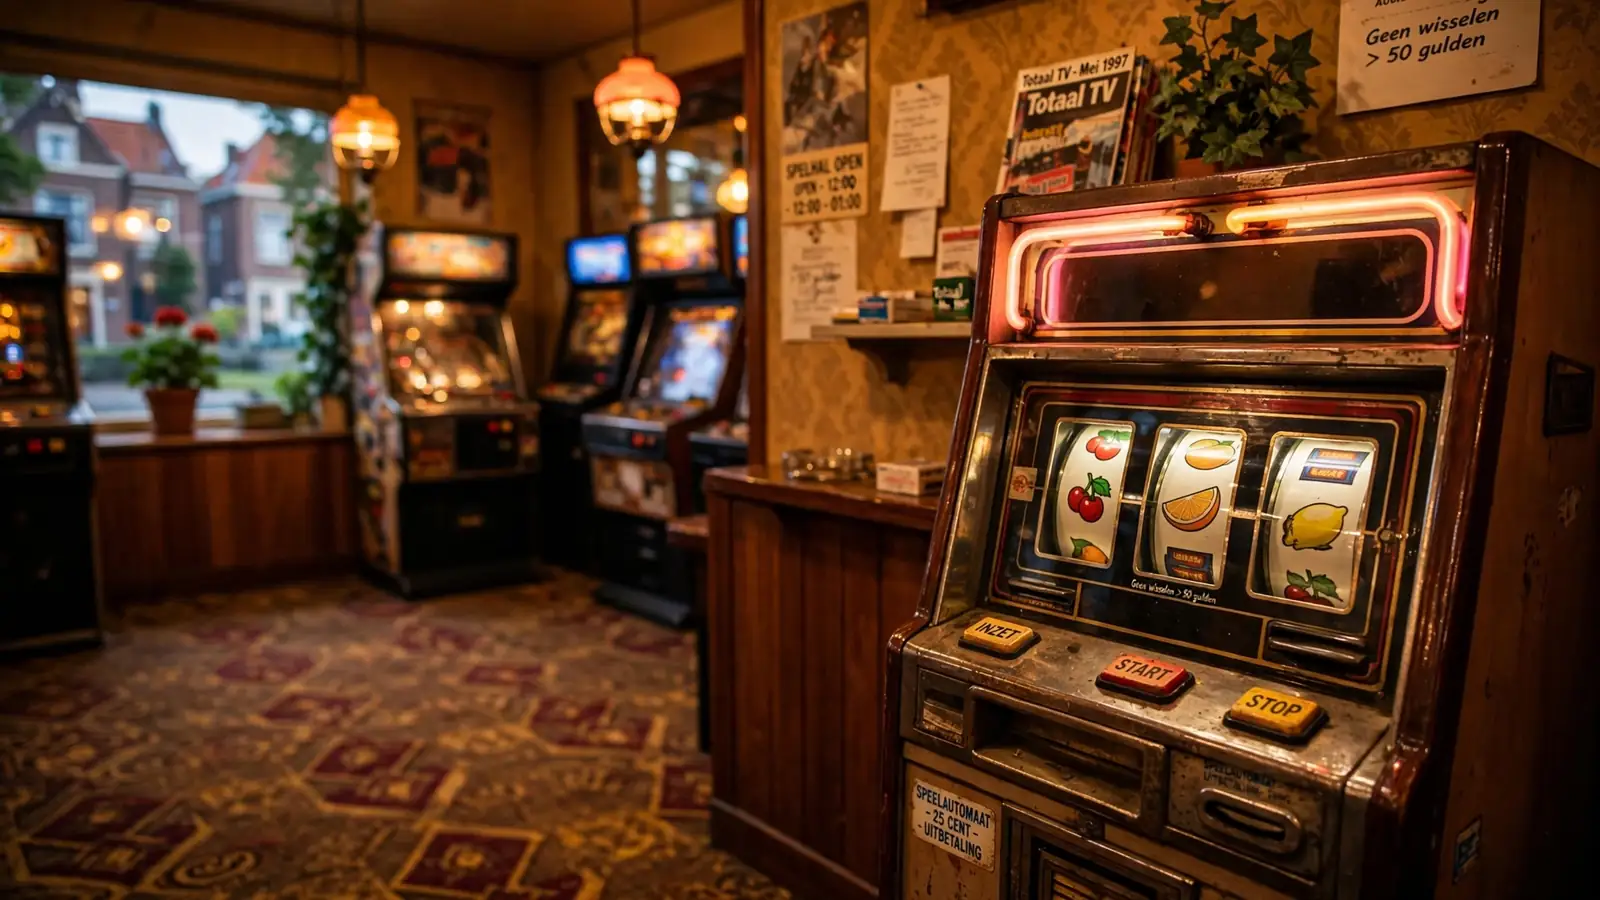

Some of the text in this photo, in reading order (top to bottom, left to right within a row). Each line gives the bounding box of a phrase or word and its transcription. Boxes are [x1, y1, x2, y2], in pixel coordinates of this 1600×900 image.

[1366, 7, 1499, 46] Geen wisselen
[1366, 33, 1486, 68] > 50 gulden
[1023, 69, 1054, 87] Totaal
[1058, 65, 1072, 81] TV
[1079, 60, 1100, 76] Mei
[1103, 54, 1129, 72] 1997
[1026, 77, 1119, 116] Totaal TV
[834, 152, 863, 172] OPEN
[1182, 588, 1193, 600] 50
[975, 622, 1022, 640] INZET
[1115, 658, 1174, 681] START
[1246, 694, 1302, 717] STOP
[916, 784, 991, 829] SPEELAUTOMAAT
[932, 809, 945, 826] 25
[947, 815, 971, 838] CENT
[924, 821, 982, 861] UITBETALING
